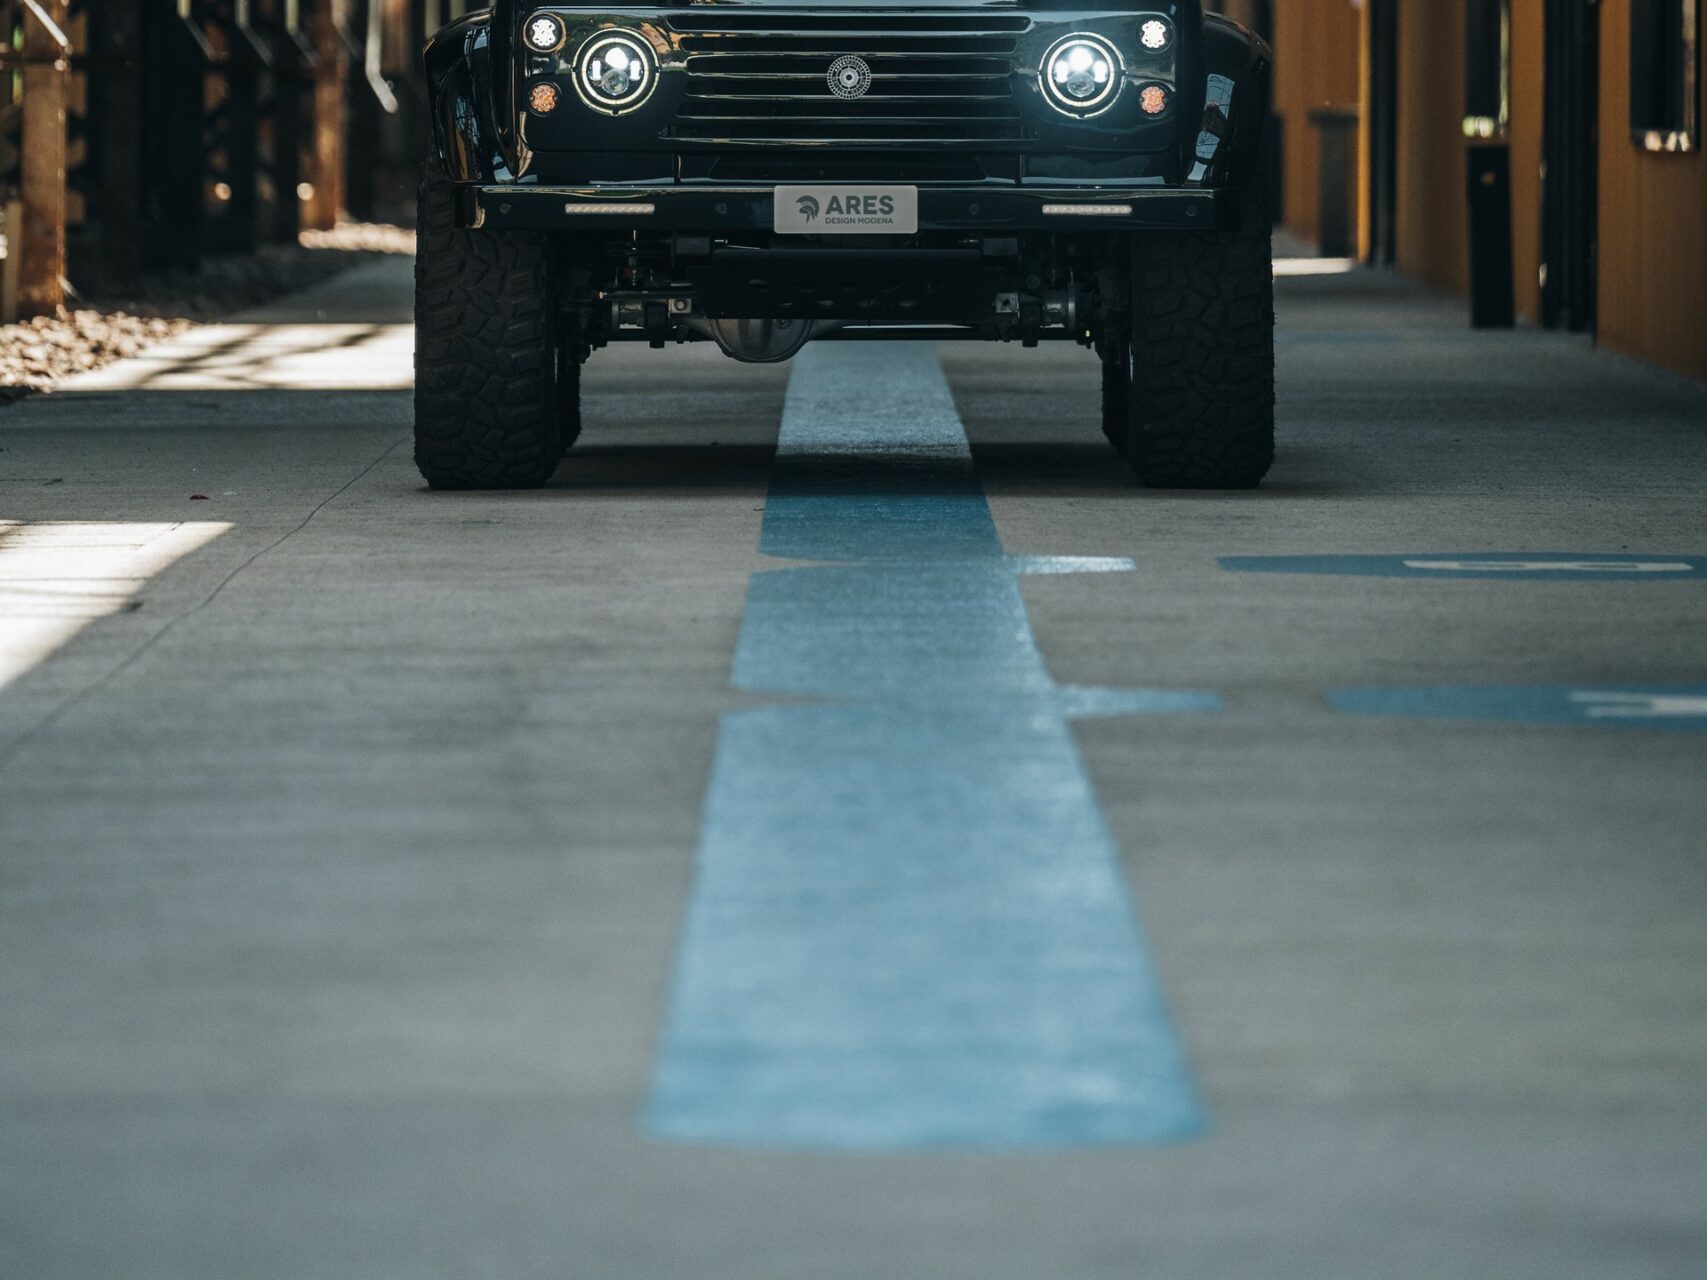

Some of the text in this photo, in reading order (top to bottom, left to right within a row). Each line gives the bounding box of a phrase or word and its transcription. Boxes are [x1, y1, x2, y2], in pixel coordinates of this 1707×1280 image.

[825, 195, 894, 215] ARES
[825, 217, 894, 225] DESIGN MODENA
